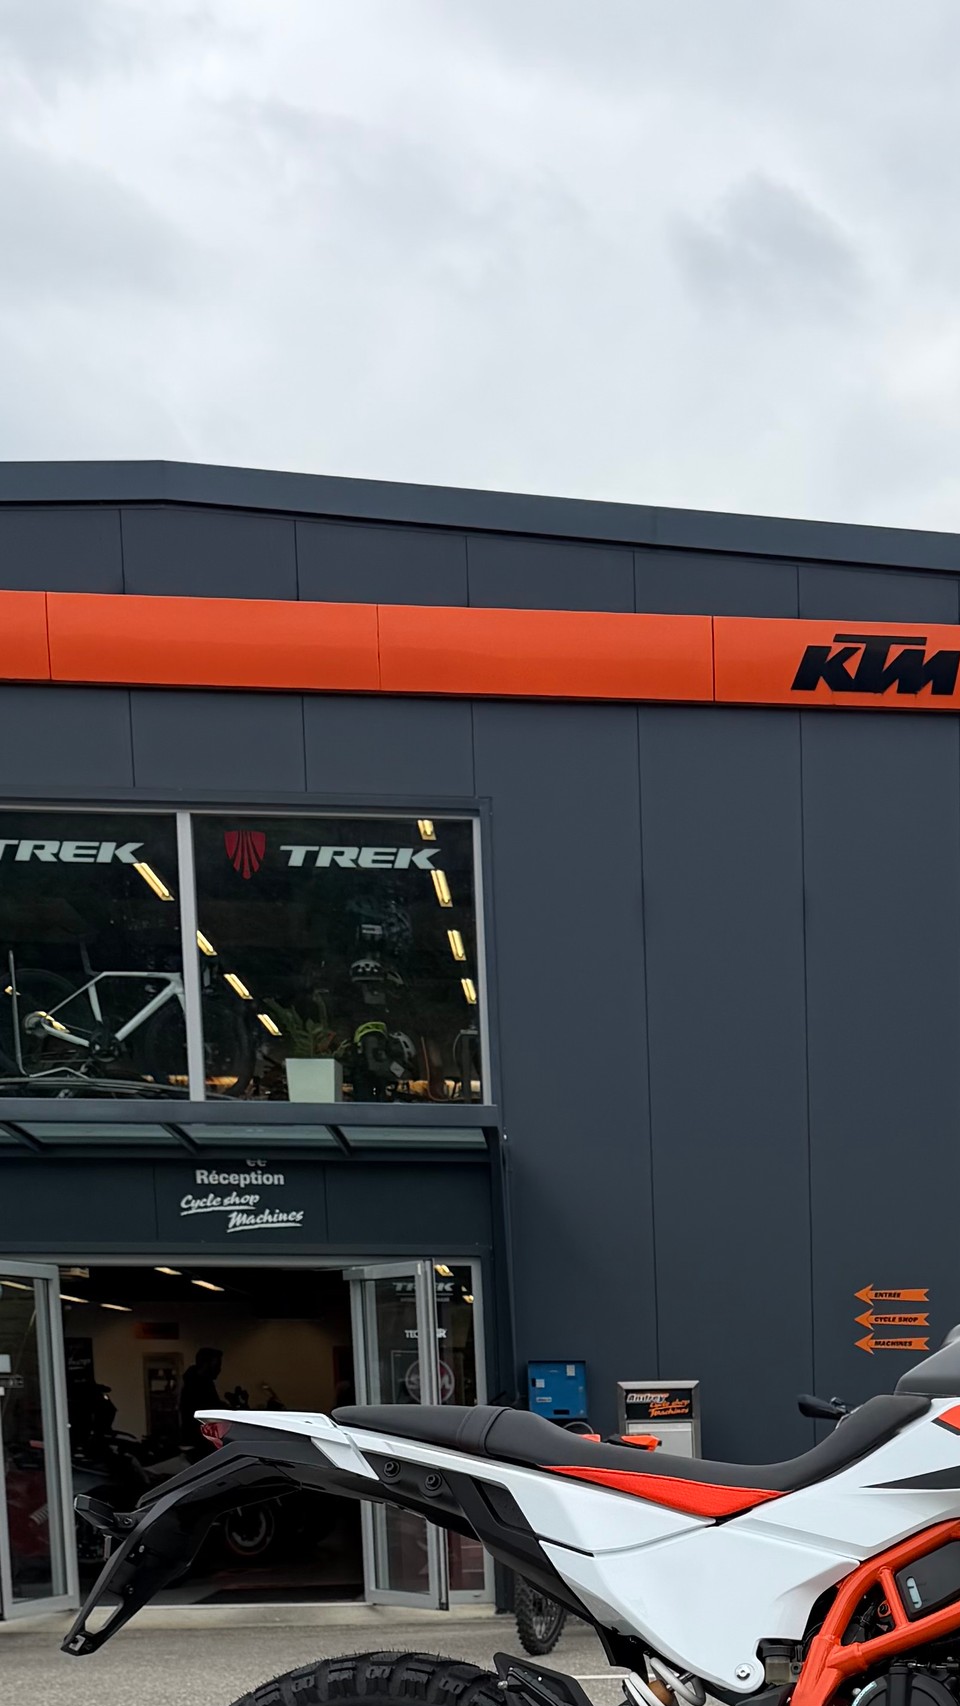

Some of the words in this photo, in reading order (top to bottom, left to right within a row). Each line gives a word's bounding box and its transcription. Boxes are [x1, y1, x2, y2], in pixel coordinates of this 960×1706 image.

[279, 845, 441, 869] TREK
[195, 1169, 285, 1188] Réception
[180, 1193, 221, 1210] Cycle
[223, 1191, 260, 1206] shop
[227, 1208, 304, 1229] Machines
